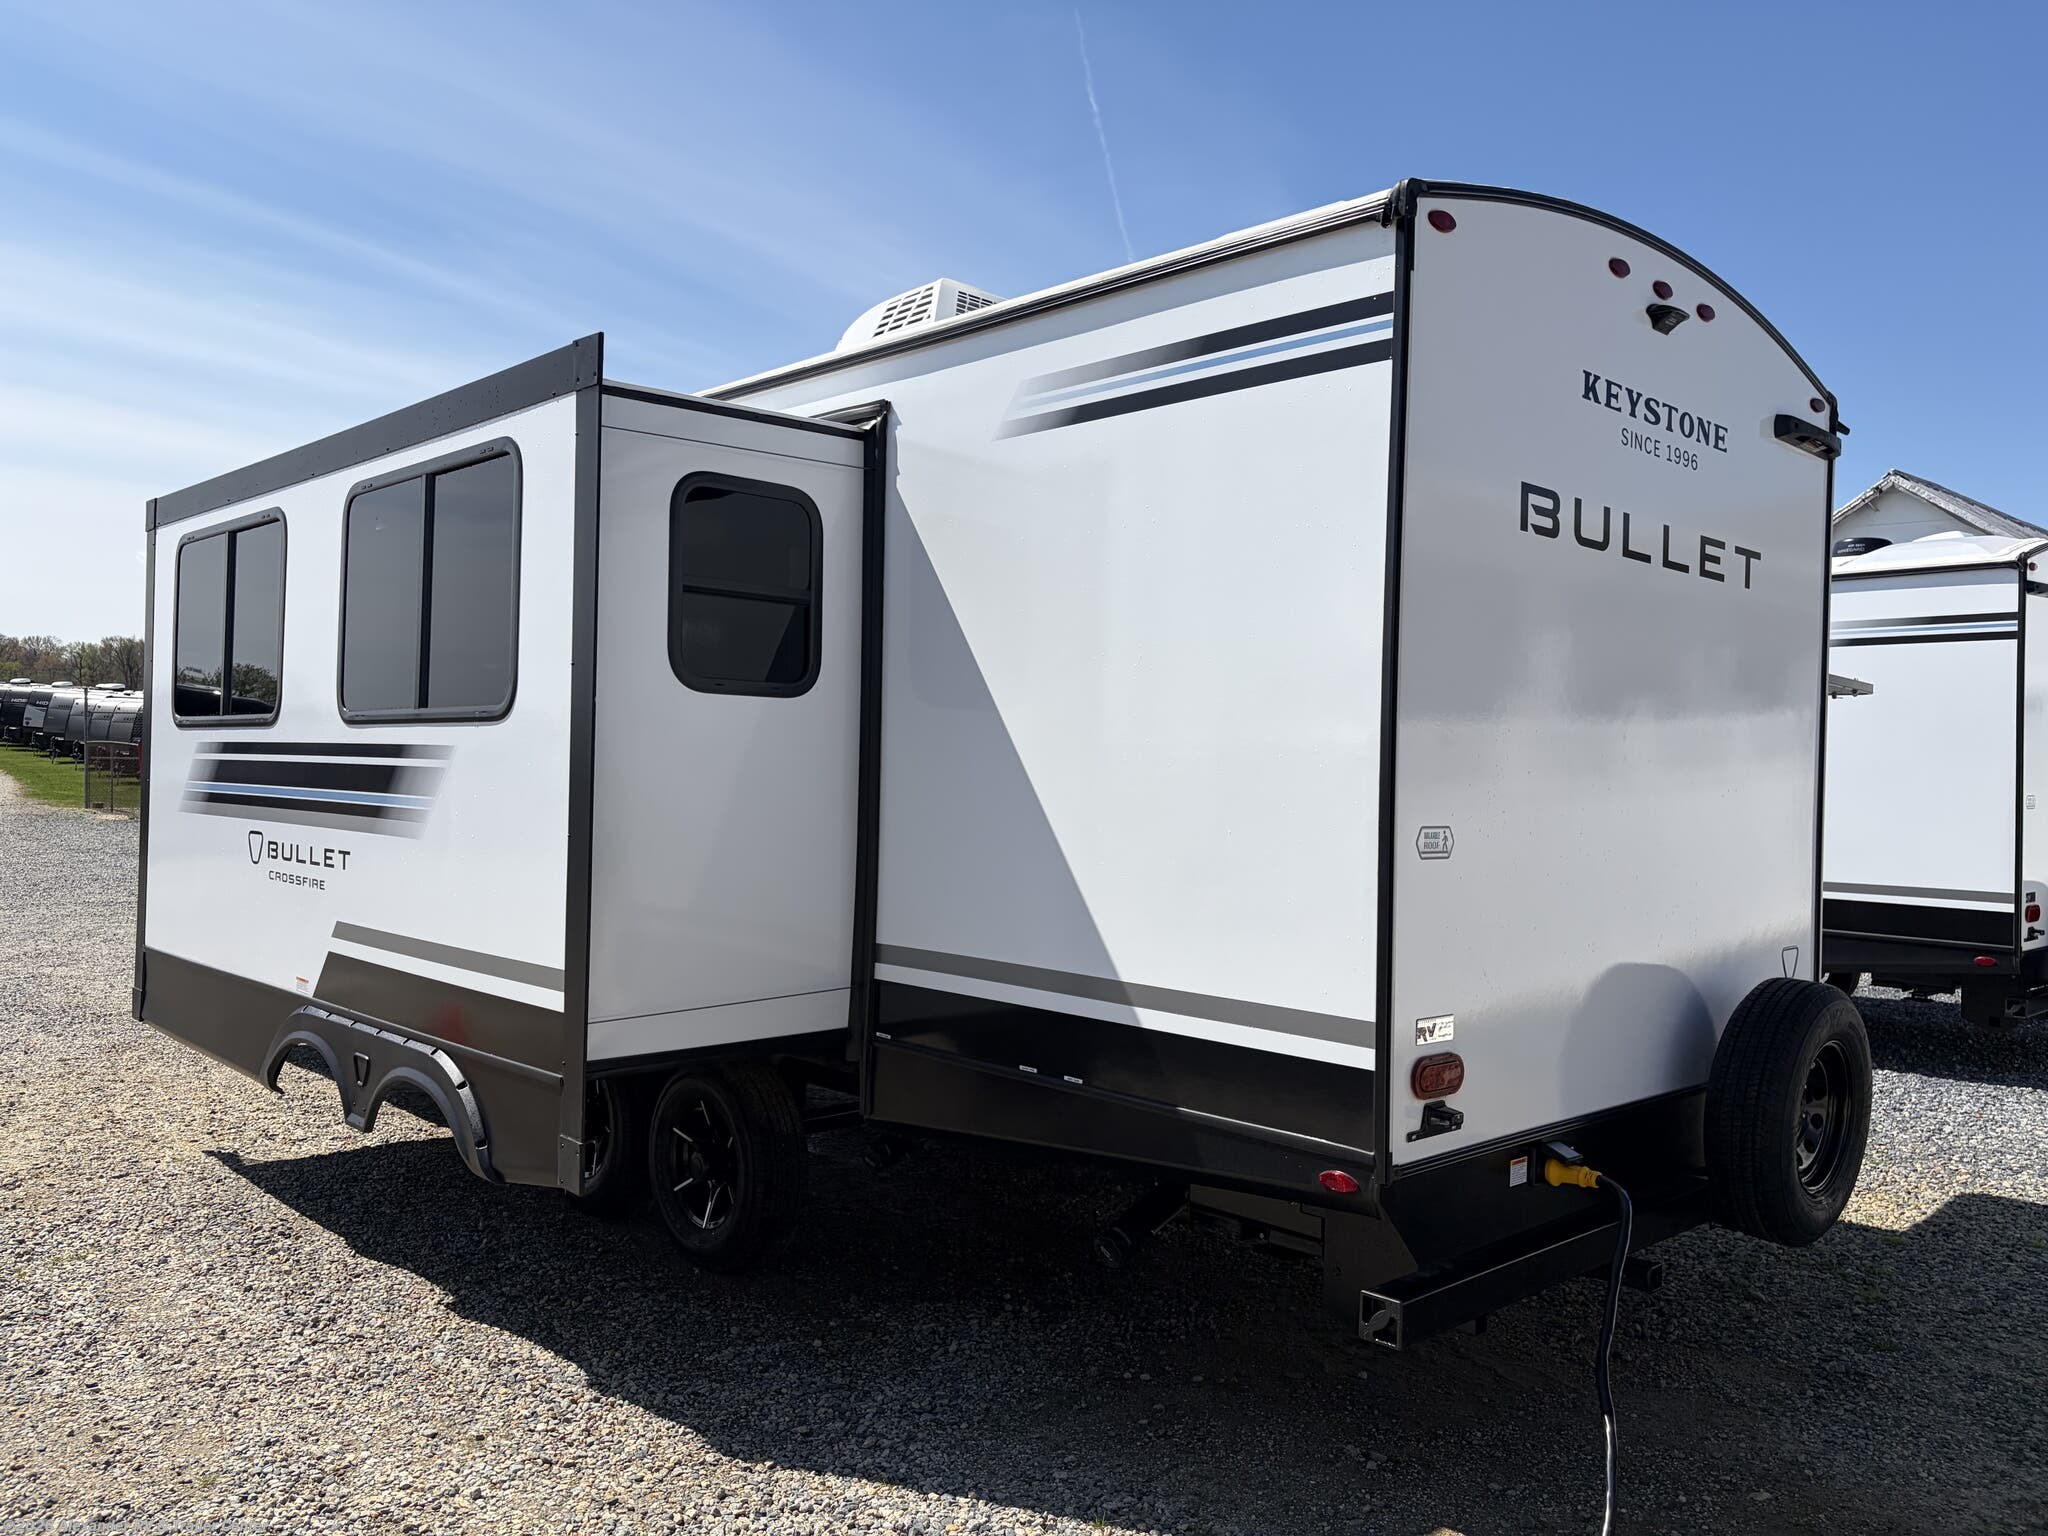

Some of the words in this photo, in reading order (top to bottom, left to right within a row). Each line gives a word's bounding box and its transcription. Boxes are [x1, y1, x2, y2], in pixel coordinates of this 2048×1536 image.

[1582, 369, 1728, 453] KEYSTONE
[1620, 427, 1661, 458] SINCE
[1665, 444, 1698, 471] 1996
[1519, 481, 1761, 590] BULLET
[267, 840, 351, 871] BULLET
[268, 870, 326, 891] CROSSFIRE
